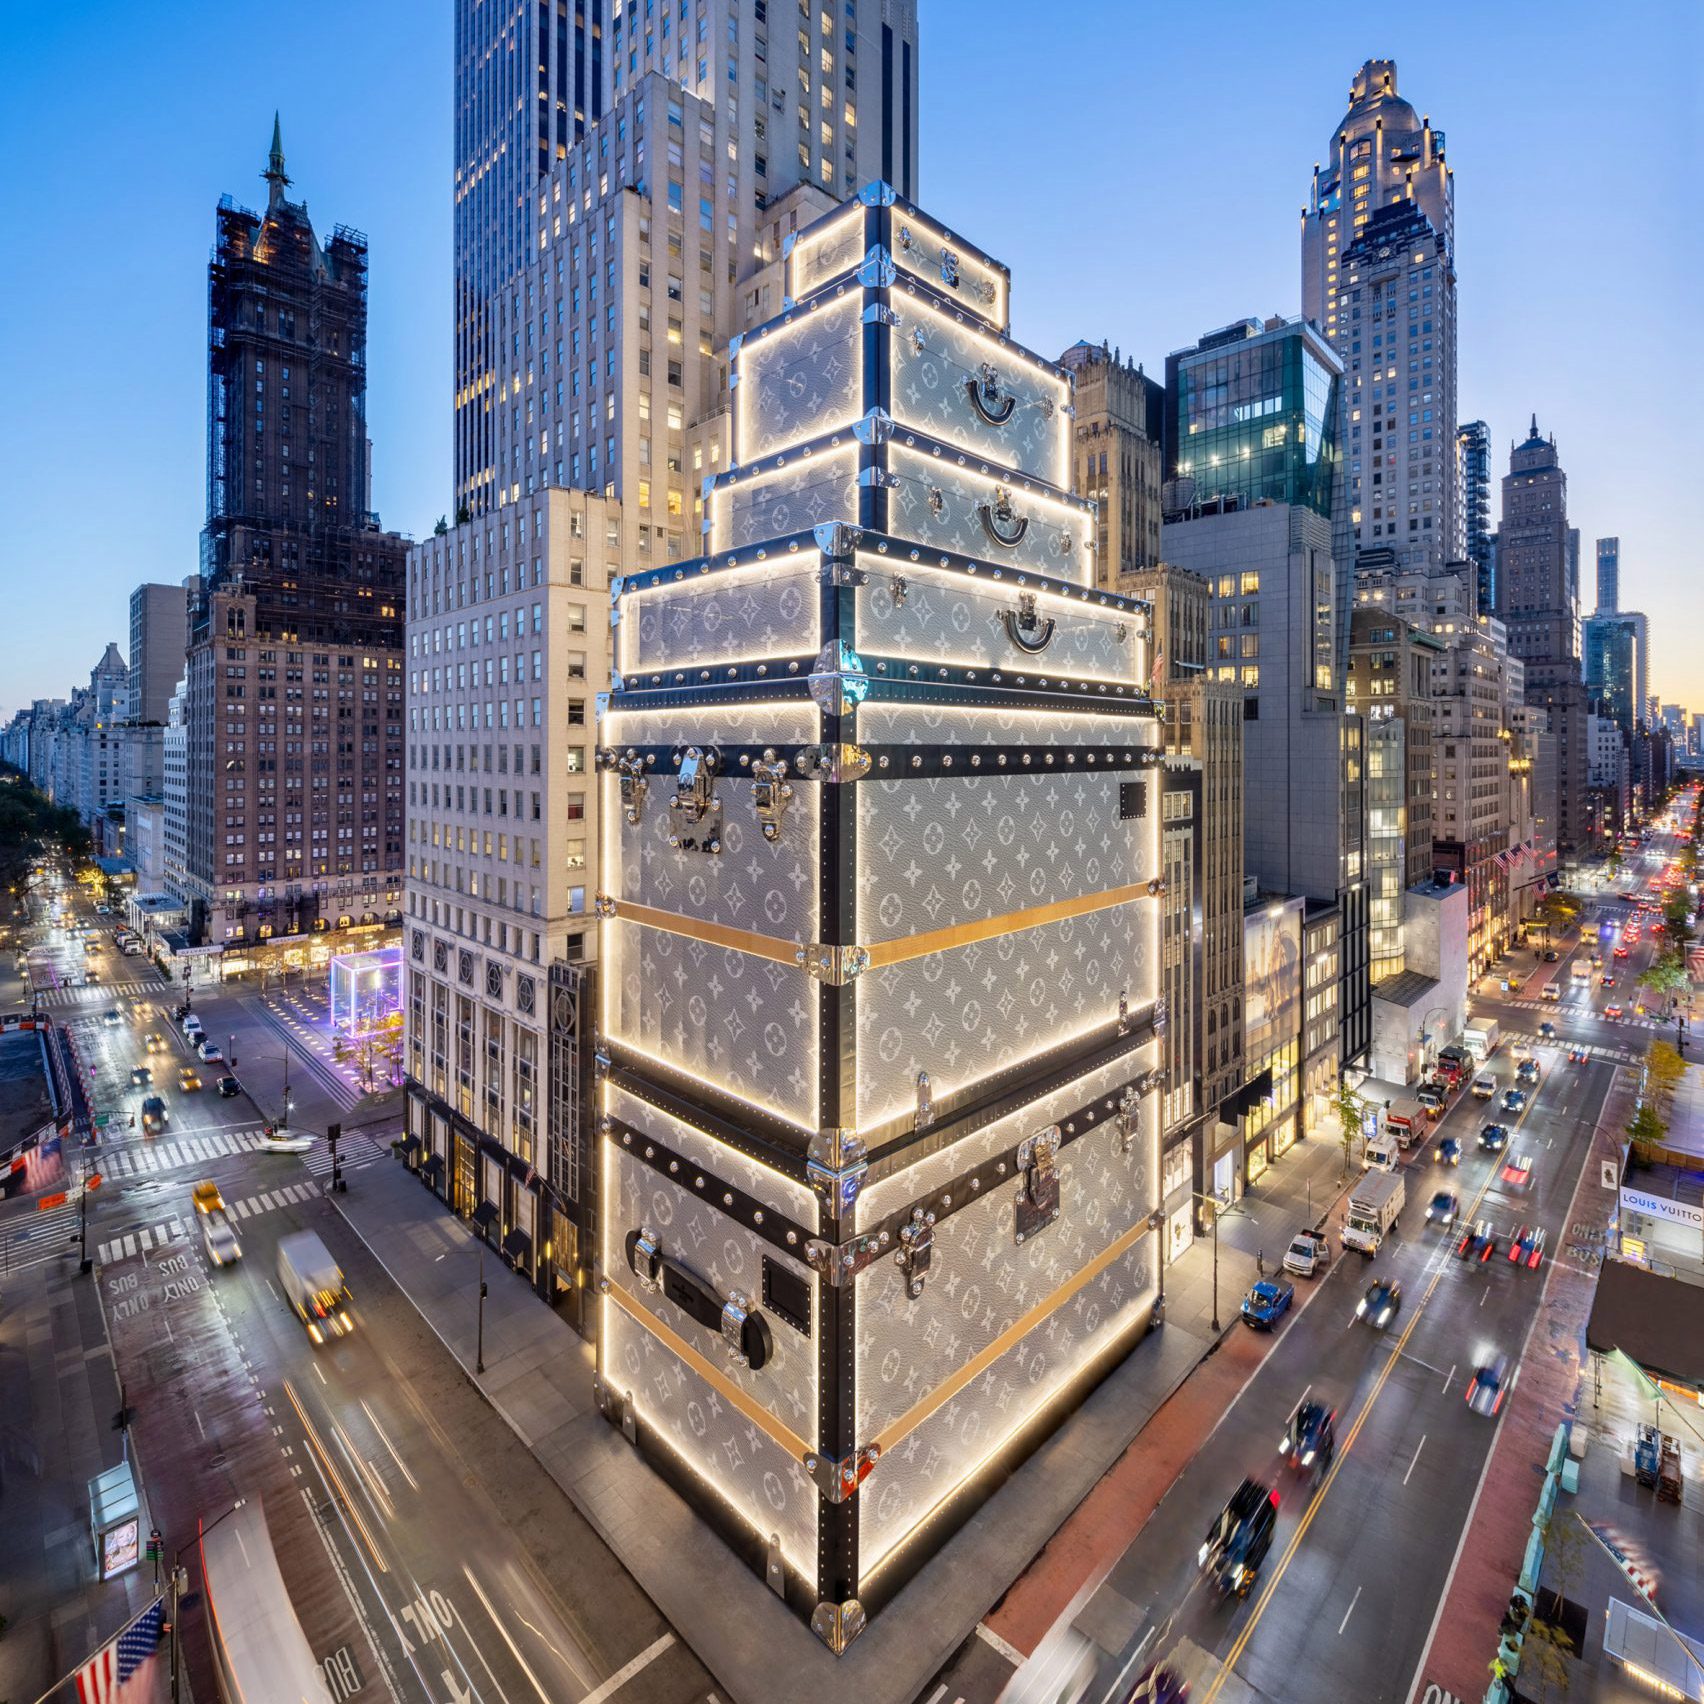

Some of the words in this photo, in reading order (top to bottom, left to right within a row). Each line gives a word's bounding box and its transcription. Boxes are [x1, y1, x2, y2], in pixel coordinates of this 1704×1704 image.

[1623, 1194, 1657, 1210] LOUIS
[1660, 1204, 1702, 1222] VUITTO
[158, 1254, 189, 1277] BUS
[1566, 1245, 1600, 1267] BUS
[108, 1273, 138, 1295] BUS
[163, 1276, 200, 1303] ONLY
[112, 1292, 149, 1322] ONLY
[391, 1590, 453, 1659] ONLY
